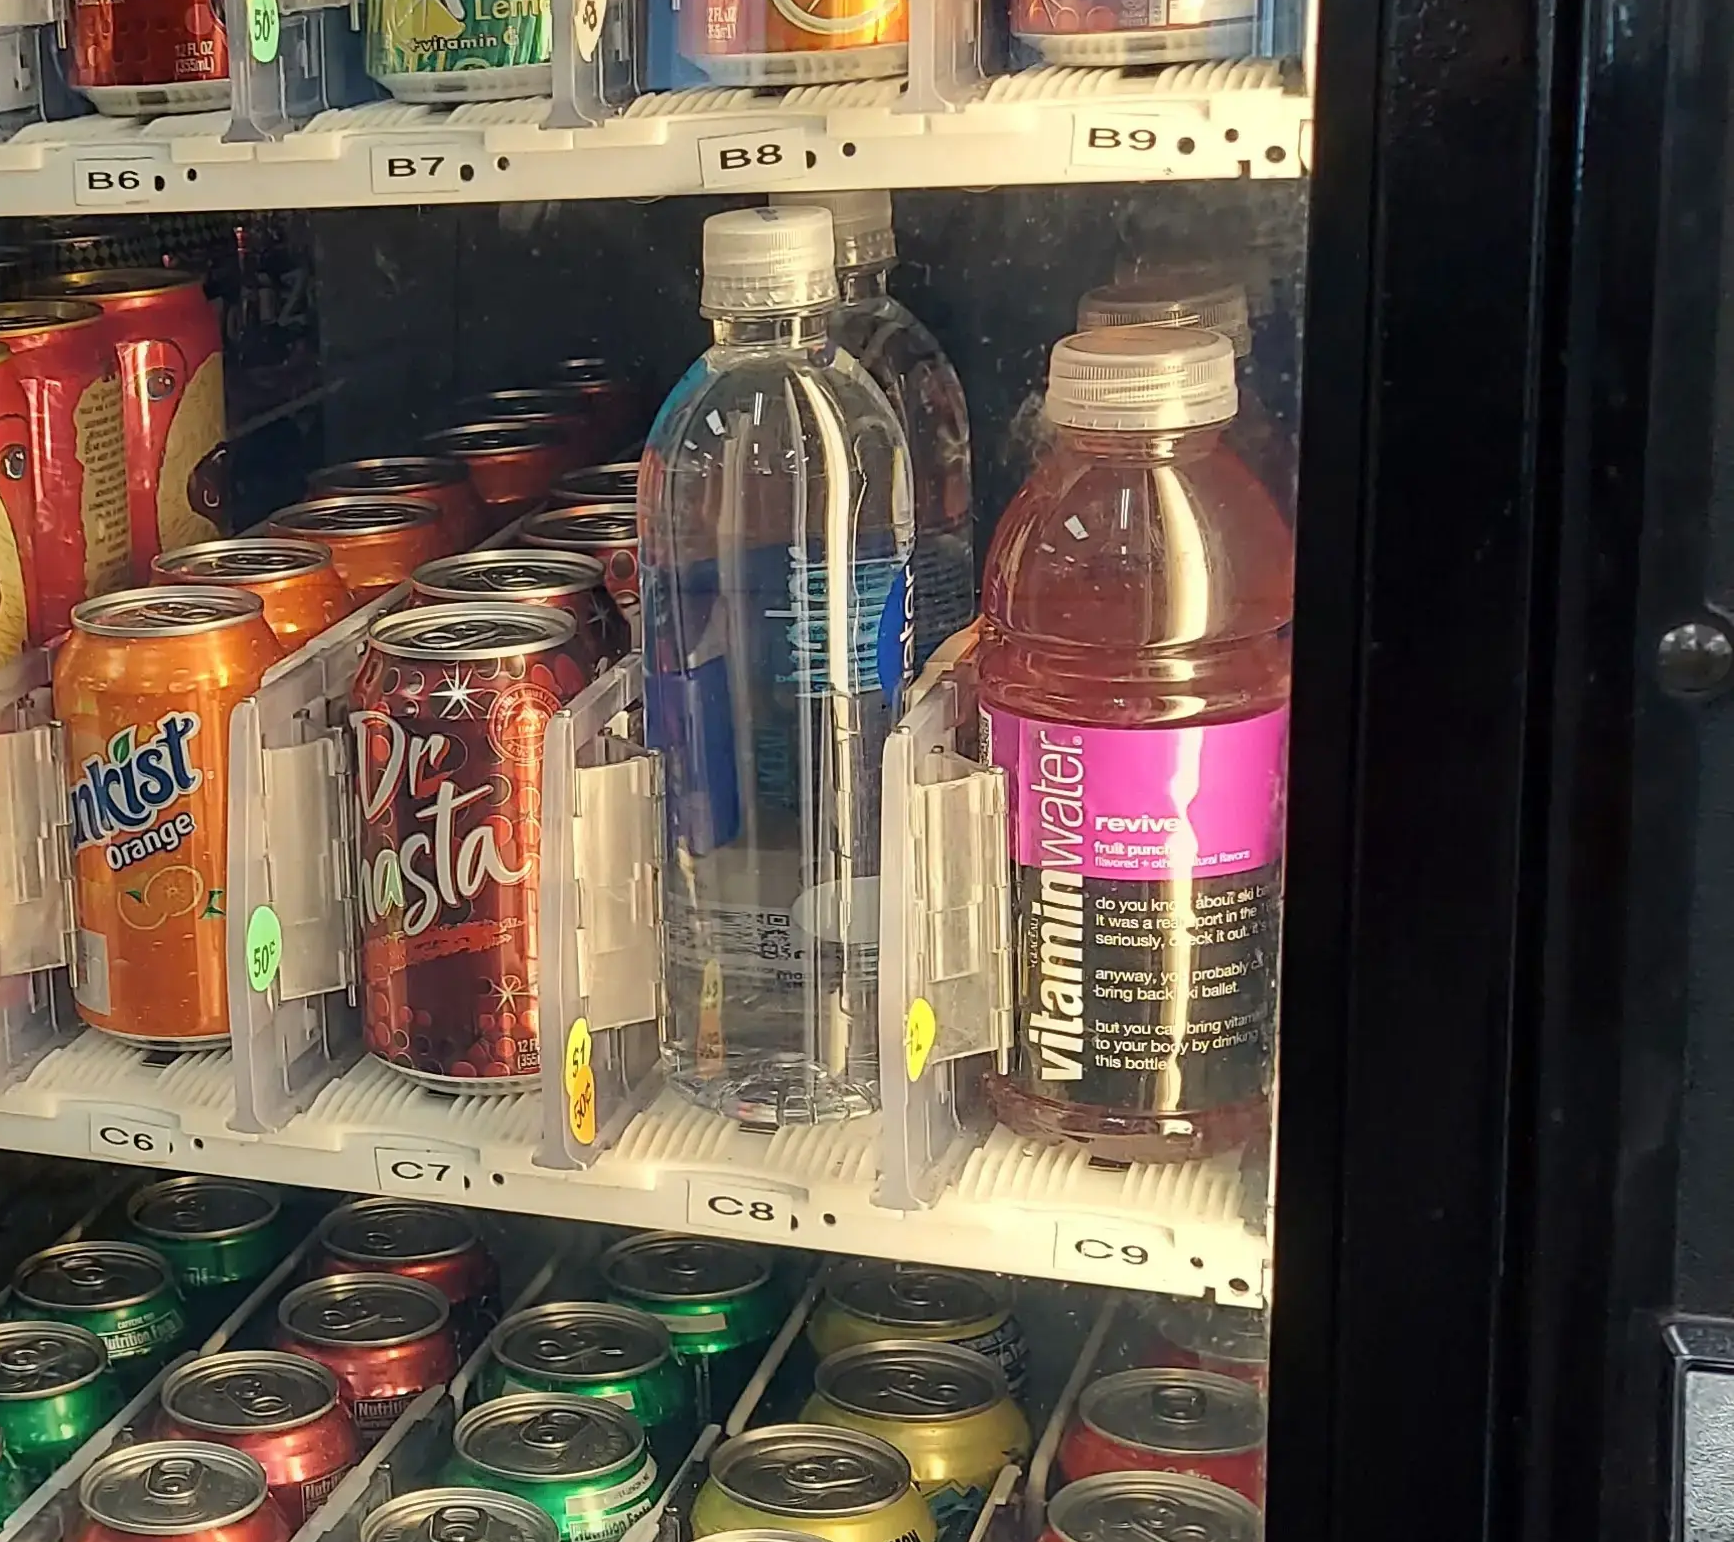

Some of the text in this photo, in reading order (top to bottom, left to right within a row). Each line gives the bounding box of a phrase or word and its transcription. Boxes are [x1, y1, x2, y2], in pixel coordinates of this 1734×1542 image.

[1088, 127, 1157, 151] B9
[388, 158, 445, 177] B7
[720, 144, 783, 171] B8
[87, 170, 139, 190] B6
[1095, 815, 1180, 833] revive
[106, 811, 195, 873] Orange
[1095, 841, 1123, 856] fruit
[1095, 857, 1137, 869] flavored
[1095, 896, 1115, 910] do
[1118, 899, 1147, 916] you
[1196, 890, 1234, 909] about
[1108, 918, 1139, 930] was
[1142, 918, 1152, 930] a
[1226, 910, 1237, 923] in
[1095, 929, 1225, 951] seriously, it
[1095, 960, 1248, 986] anyway, probably
[1096, 985, 1174, 1003] bring back
[1095, 1019, 1221, 1039] but you bring
[1095, 1036, 1110, 1050] to
[1113, 1039, 1147, 1054] your
[1151, 1037, 1189, 1056] body
[1192, 1036, 1210, 1053] by
[1095, 1054, 1121, 1068] this
[99, 1127, 154, 1153] C6
[391, 1162, 451, 1185] C7
[708, 1195, 775, 1222] C8
[1074, 1238, 1149, 1265] C9
